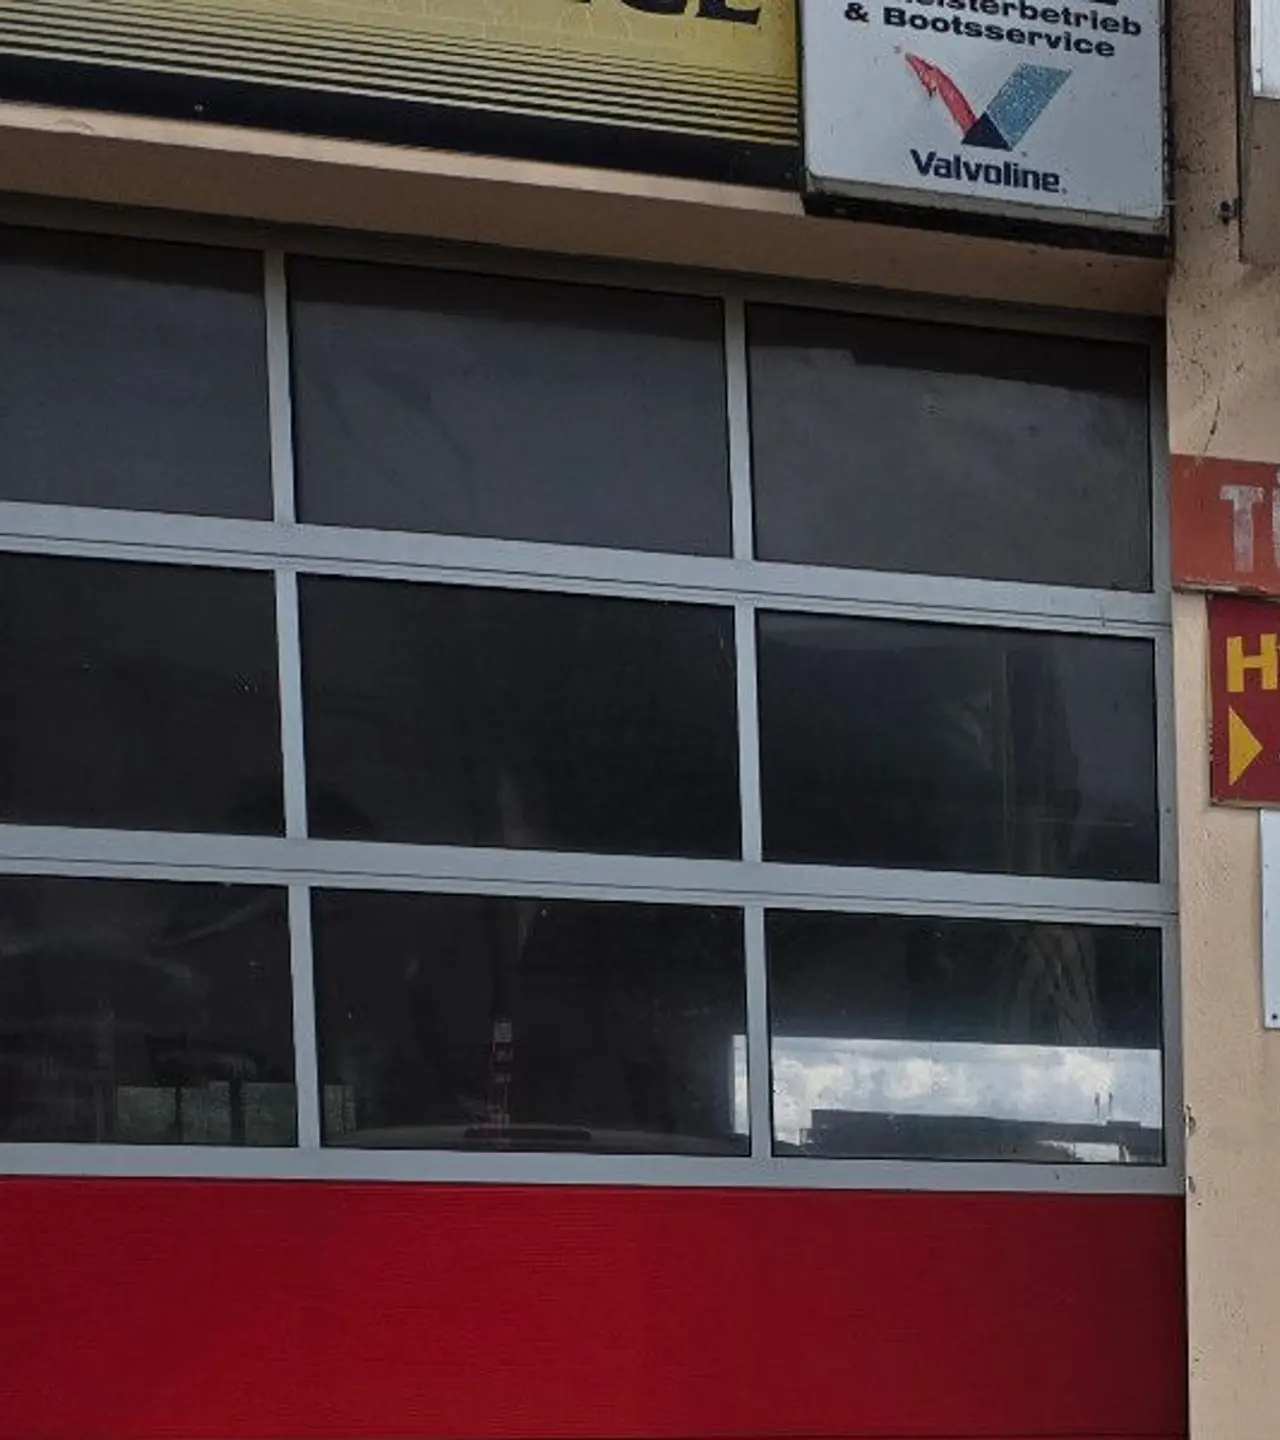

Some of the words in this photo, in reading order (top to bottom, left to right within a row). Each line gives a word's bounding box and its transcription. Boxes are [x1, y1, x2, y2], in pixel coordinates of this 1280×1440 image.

[844, 1, 870, 23] &
[883, 6, 1116, 57] Bootsservice
[909, 148, 1061, 193] Valvoline
